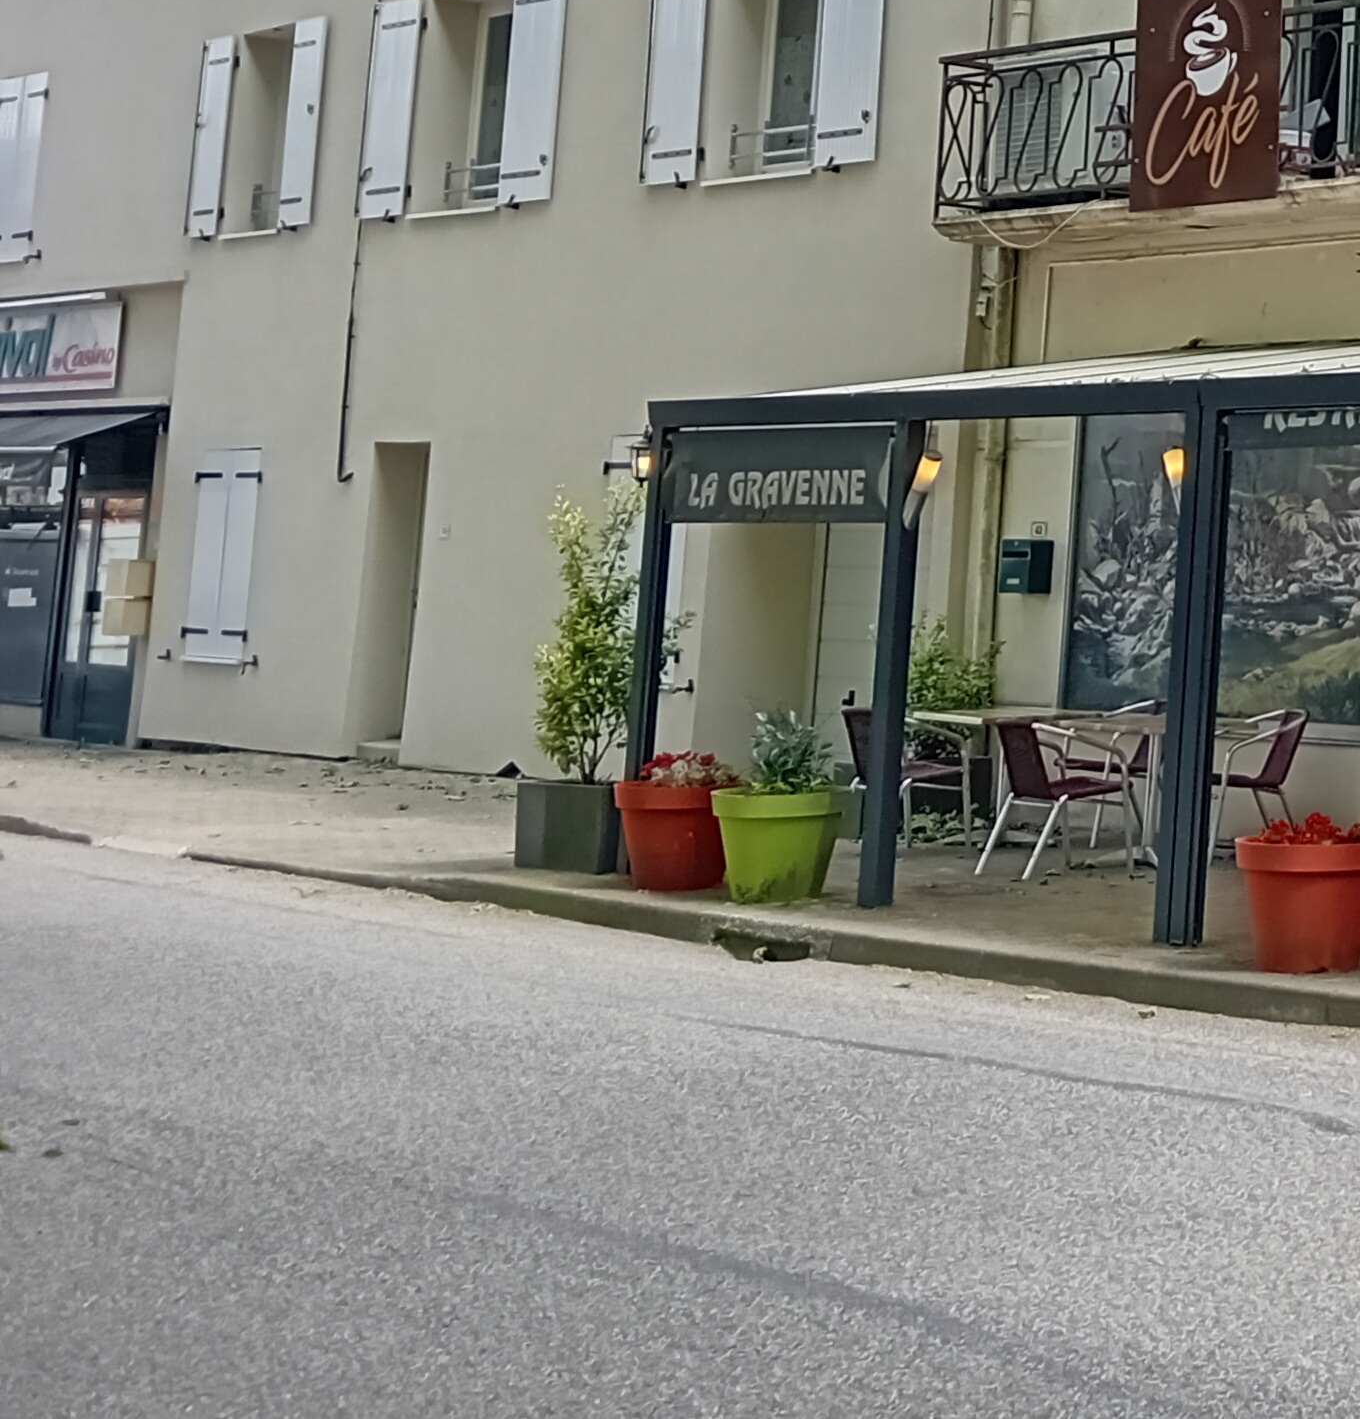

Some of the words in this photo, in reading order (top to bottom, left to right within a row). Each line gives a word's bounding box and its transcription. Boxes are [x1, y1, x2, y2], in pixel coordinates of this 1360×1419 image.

[1145, 71, 1260, 190] Café
[0, 312, 56, 377] ival
[62, 341, 115, 374] Casino
[687, 471, 719, 510] LA
[728, 469, 866, 510] GRAVENNE
